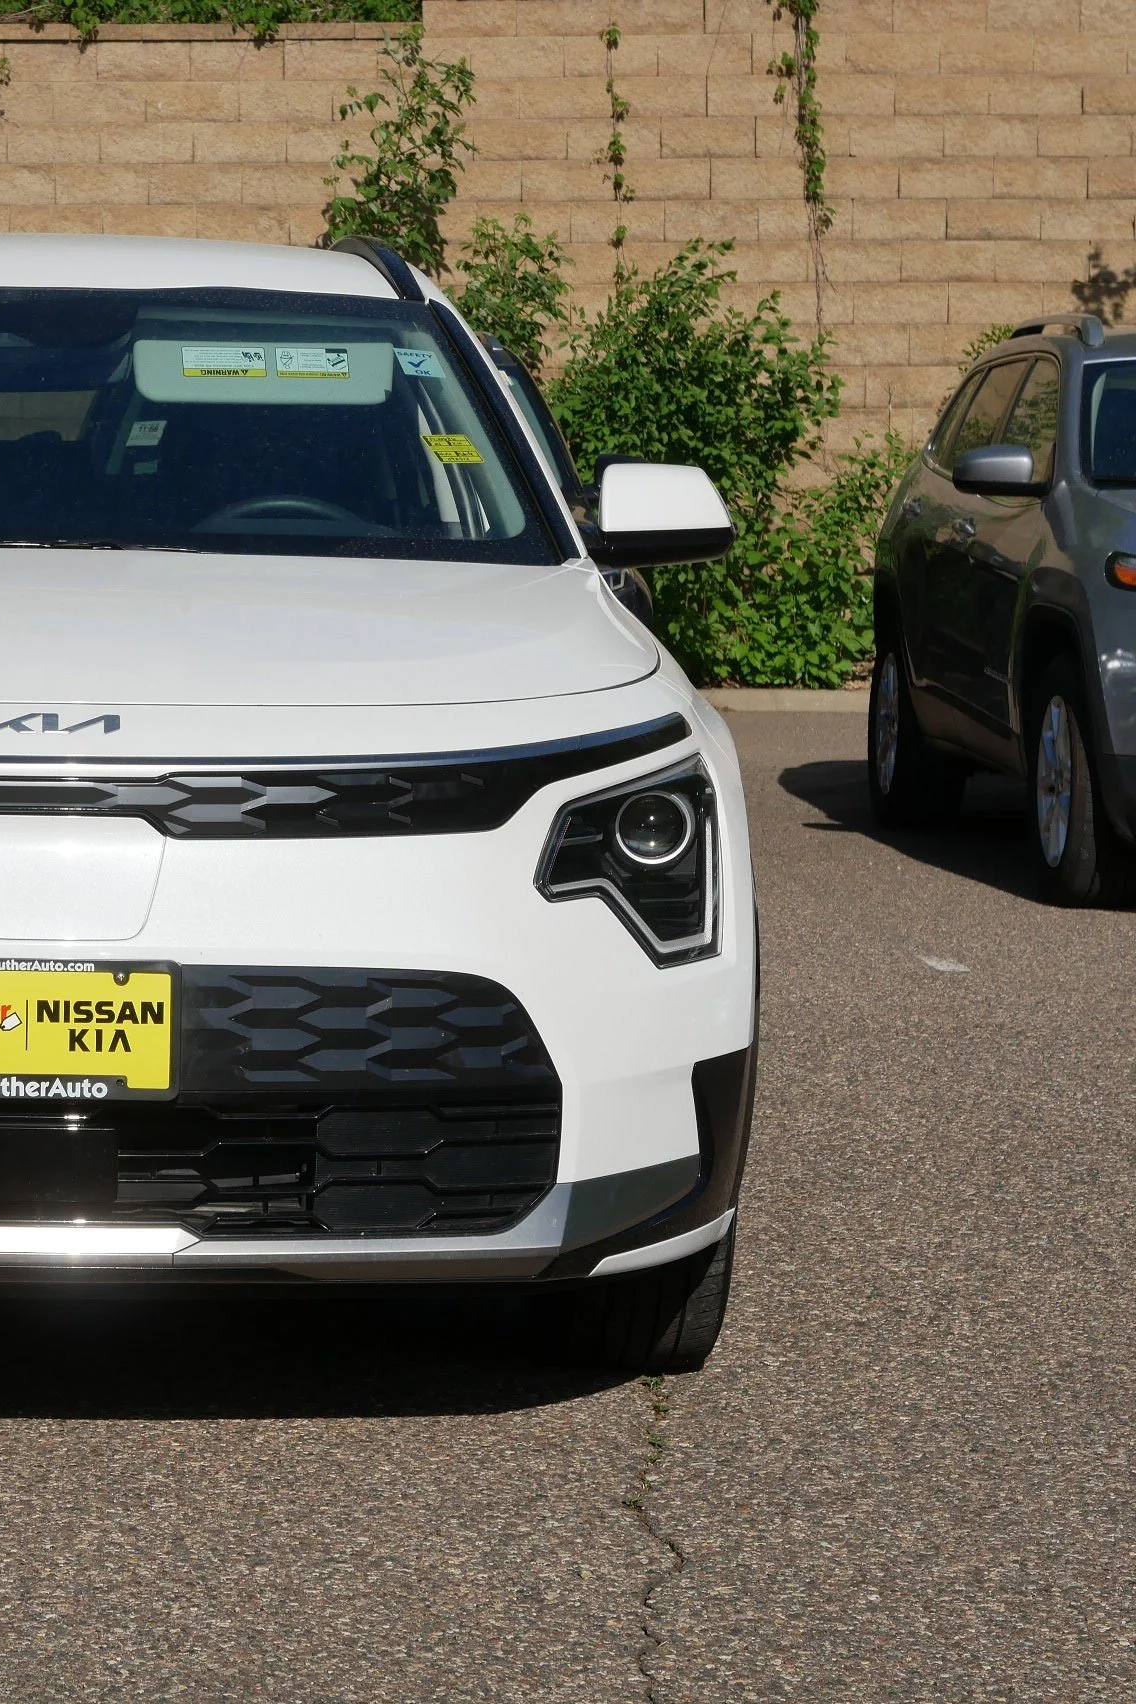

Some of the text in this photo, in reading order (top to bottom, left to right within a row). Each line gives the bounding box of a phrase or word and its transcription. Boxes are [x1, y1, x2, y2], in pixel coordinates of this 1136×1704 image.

[396, 351, 433, 359] SAFETY
[36, 1000, 165, 1025] NISSAN
[67, 1029, 132, 1053] KIA
